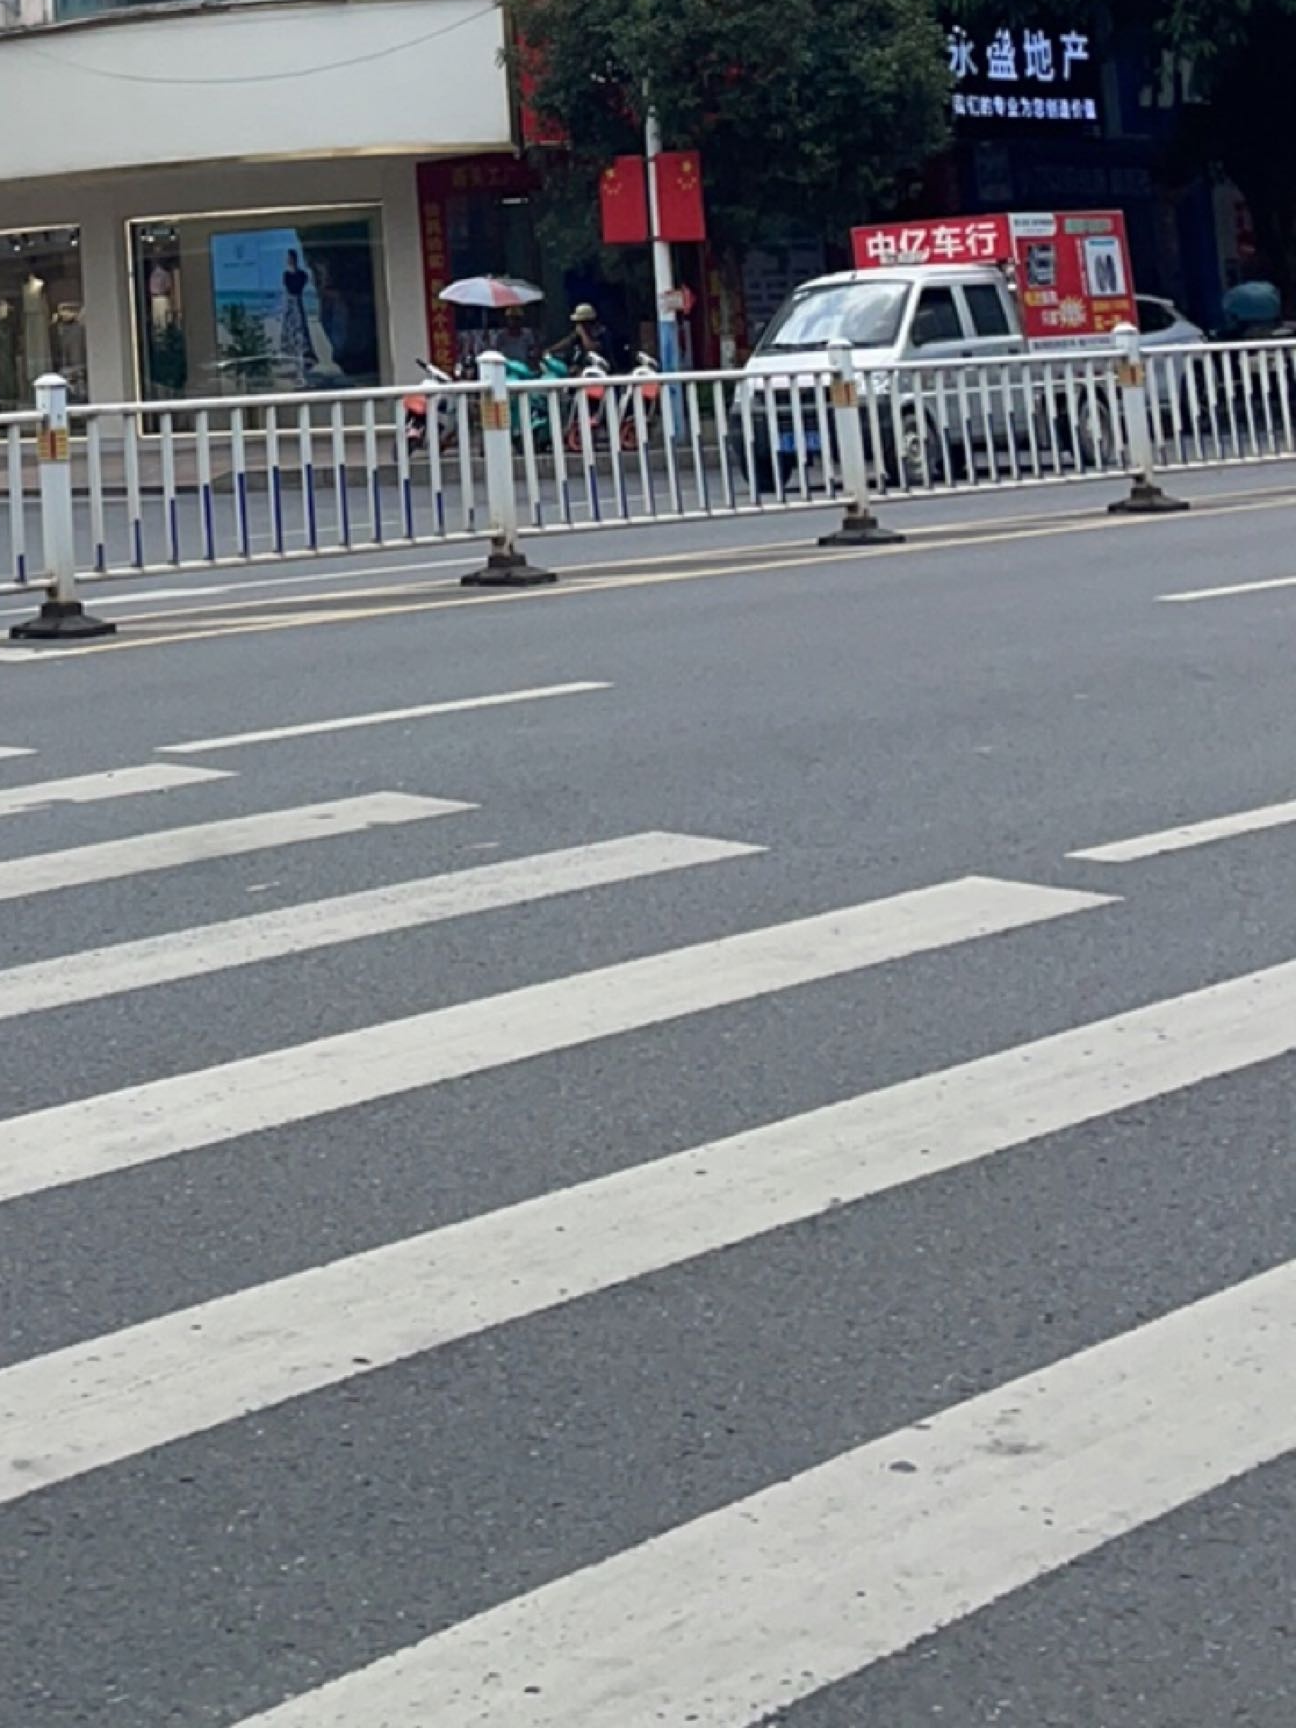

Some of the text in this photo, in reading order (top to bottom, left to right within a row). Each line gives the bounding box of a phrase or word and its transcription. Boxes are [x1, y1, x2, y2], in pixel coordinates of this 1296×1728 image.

[947, 25, 1090, 82] 永盛地产
[865, 222, 999, 260] 中亿车行
